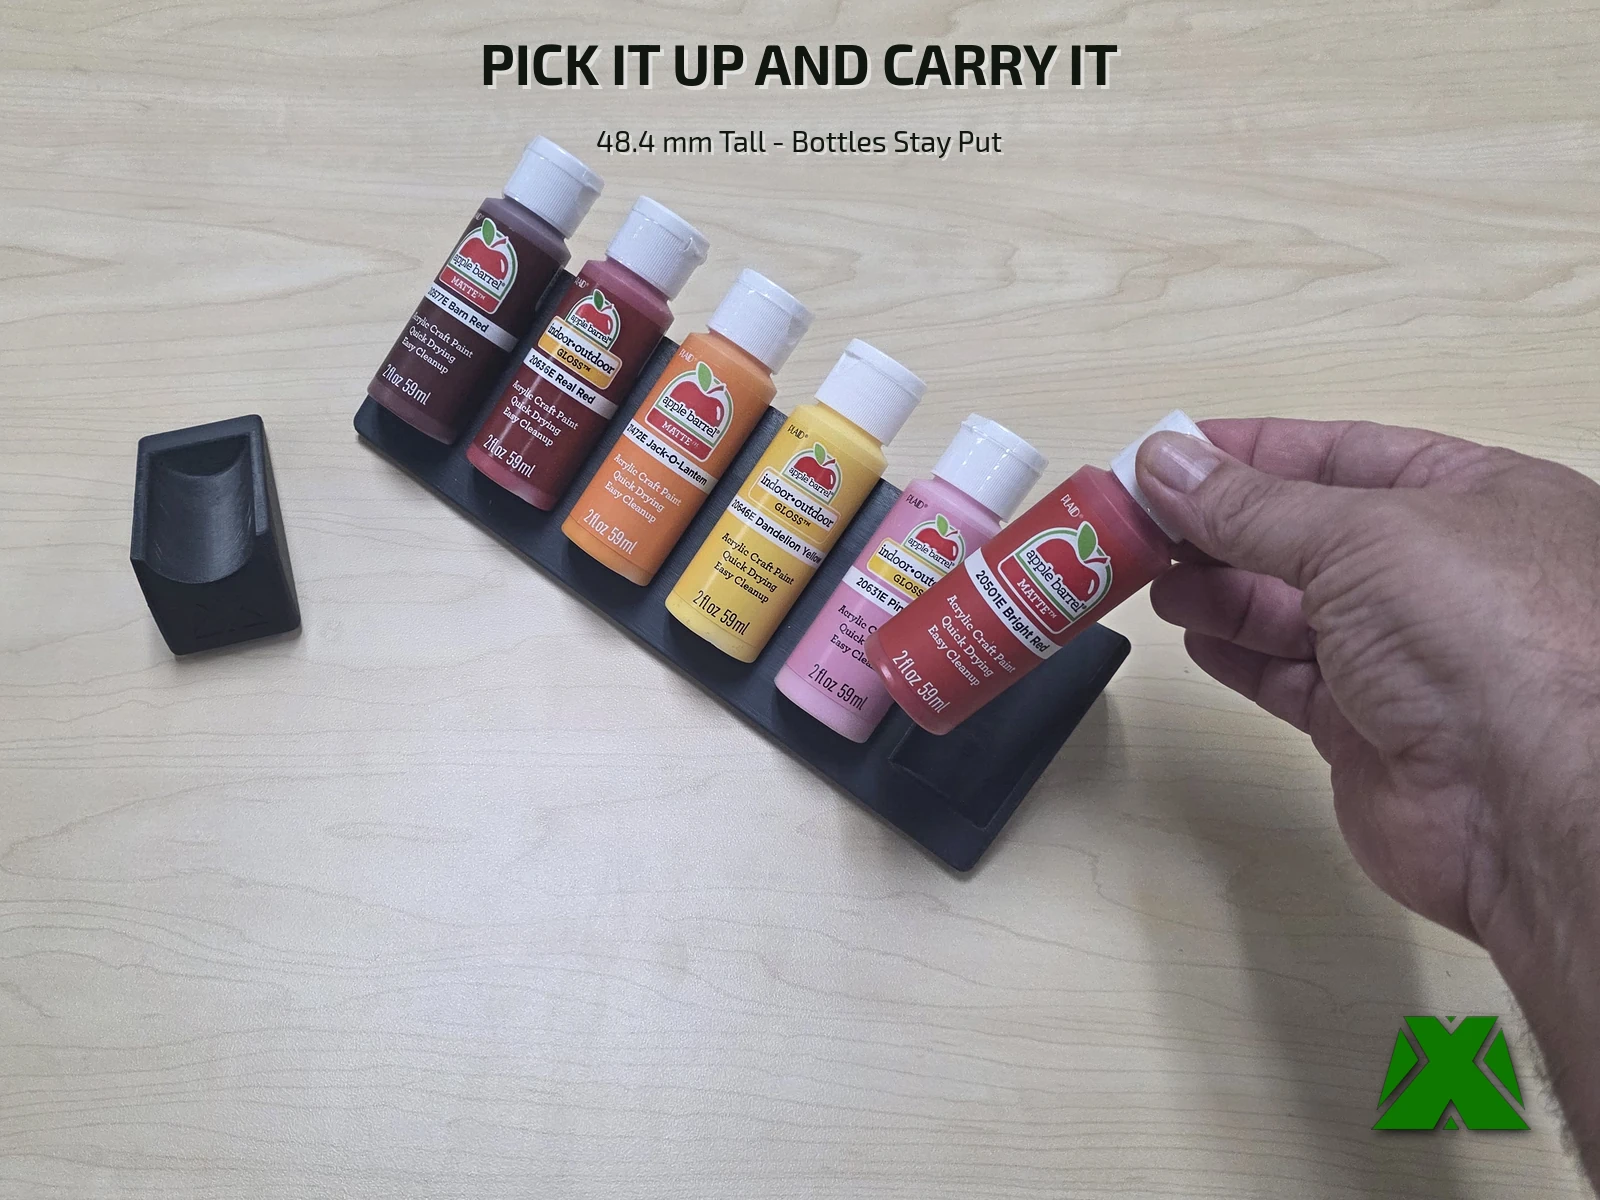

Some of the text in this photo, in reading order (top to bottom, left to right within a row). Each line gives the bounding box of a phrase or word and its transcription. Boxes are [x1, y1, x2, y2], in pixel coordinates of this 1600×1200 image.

[453, 254, 472, 270] apple
[411, 312, 473, 358] Acrylic Craft Paint
[448, 301, 470, 321] Barn
[469, 316, 489, 333] Red
[570, 314, 587, 330] apple
[401, 337, 449, 374] Easy Cleanup
[409, 326, 456, 364] Quick Drying
[402, 380, 431, 405] 59ml
[529, 355, 596, 404] 20636E Real Red
[511, 396, 562, 436] Quick Drying
[512, 380, 579, 430] Acrylic Craft Paint
[662, 396, 687, 417] apple
[503, 406, 554, 447] Easy Cleanup
[506, 451, 535, 478] 59ml
[614, 453, 682, 507] Acrylic Craft Paint
[788, 466, 809, 484] apple
[604, 481, 657, 524] Easy Cleanup
[613, 471, 665, 513] Quick Drying
[608, 526, 638, 555] 59ml
[754, 516, 801, 552] Dandelion
[802, 546, 822, 564] Yellow
[908, 537, 929, 556] apple
[722, 532, 795, 586] Acrylic Craft Paint
[722, 550, 777, 593] Quick Drying
[1026, 549, 1054, 583] apple
[714, 561, 769, 604] Easy Cleanup
[856, 576, 888, 602] 20631E
[720, 609, 751, 636] 59ml
[838, 604, 866, 629] Acrylic
[975, 570, 1050, 652] 20501E Bright Red
[830, 634, 851, 654] Easy
[839, 623, 865, 645] Quick
[941, 615, 993, 677] Quick Drying
[947, 594, 1016, 674] Acrylic Craft Paint
[927, 624, 980, 687] Easy Cleanup
[836, 683, 868, 711] 59ml
[917, 682, 950, 714] 59ml
